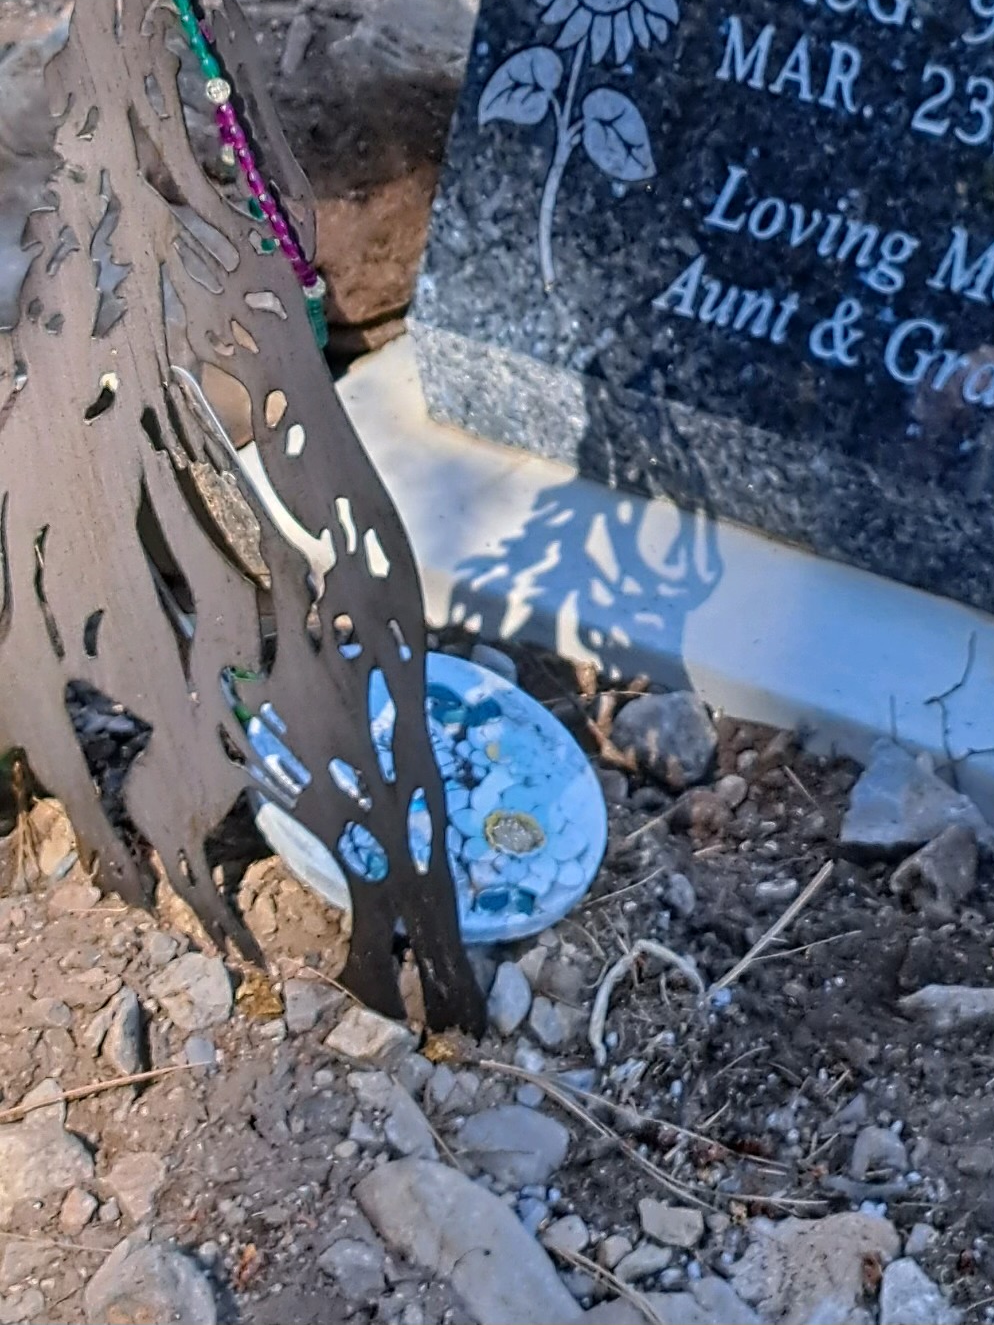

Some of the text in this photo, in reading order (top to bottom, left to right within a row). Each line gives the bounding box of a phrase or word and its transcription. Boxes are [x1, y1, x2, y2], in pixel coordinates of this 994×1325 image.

[714, 14, 874, 118] MAR.
[703, 166, 921, 295] Loving
[651, 253, 800, 344] Aunt
[808, 297, 864, 366] &
